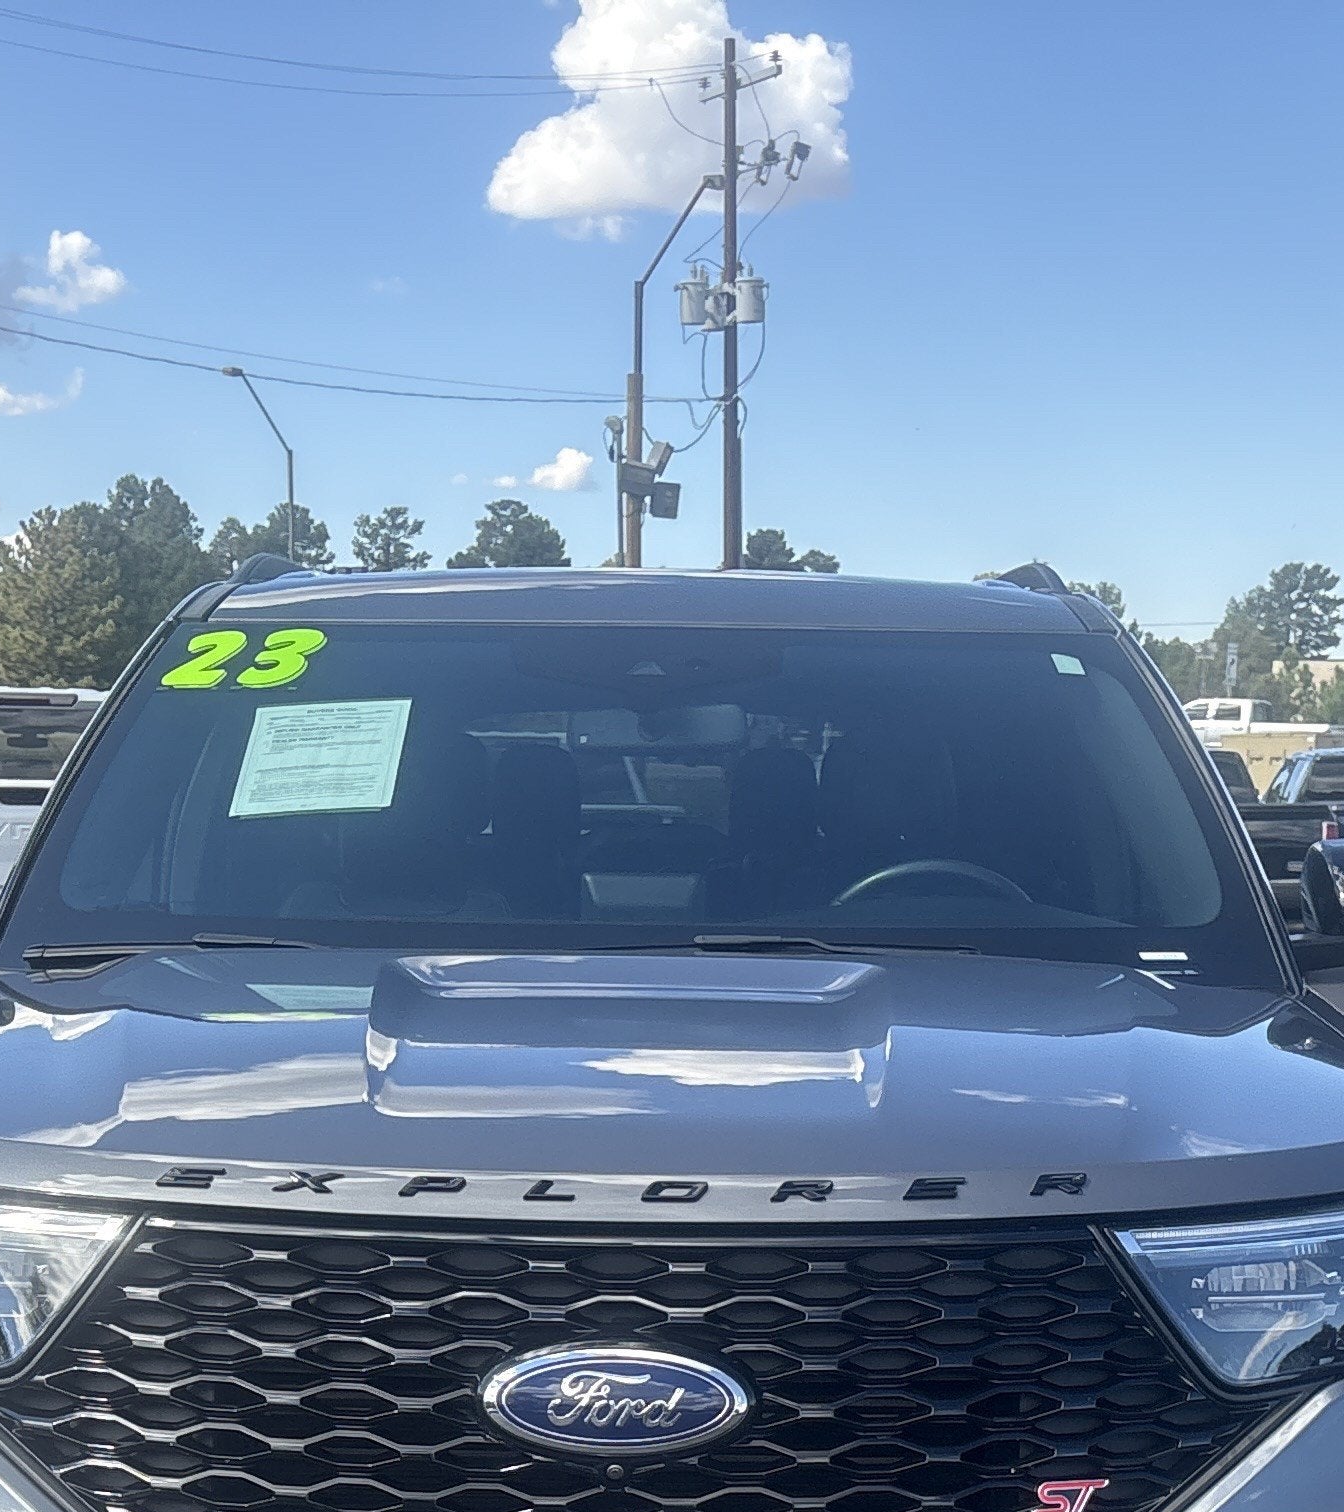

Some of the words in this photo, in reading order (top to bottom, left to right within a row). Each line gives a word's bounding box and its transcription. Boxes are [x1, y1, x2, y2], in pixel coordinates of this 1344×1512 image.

[161, 628, 328, 689] 23
[153, 1166, 1089, 1204] EXPLORER
[546, 1369, 685, 1428] Ford
